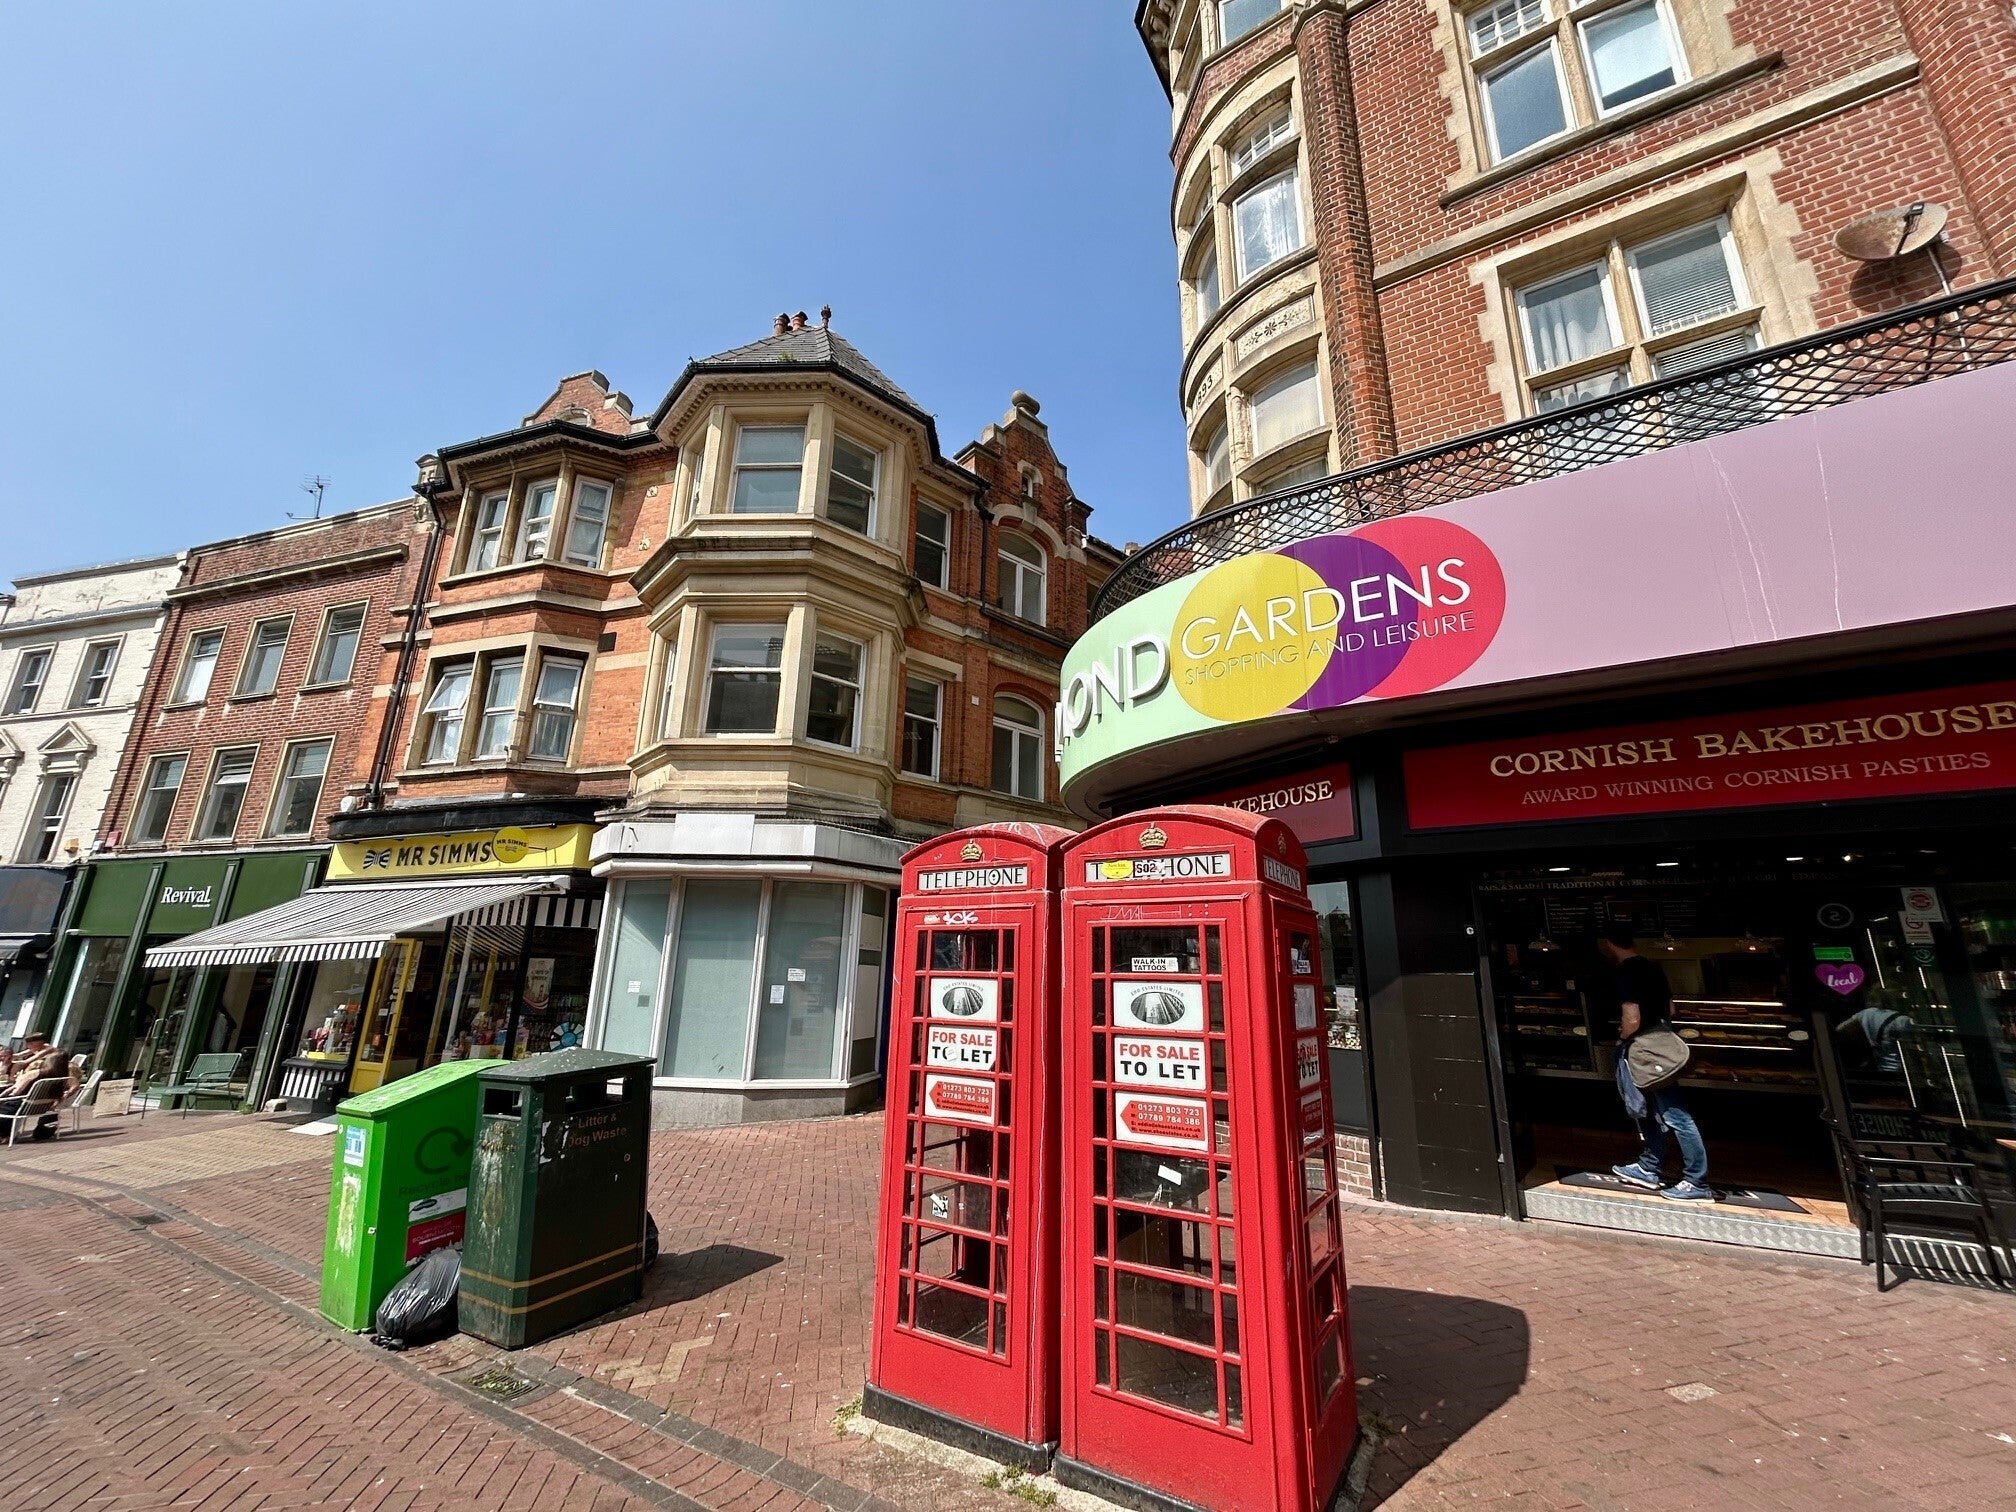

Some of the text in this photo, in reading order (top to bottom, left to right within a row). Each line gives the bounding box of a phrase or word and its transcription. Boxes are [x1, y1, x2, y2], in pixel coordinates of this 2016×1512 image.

[1181, 558, 1471, 660] GARDENS
[1185, 610, 1476, 686] SHOPPING AND LEISURE
[1490, 700, 2016, 778] CORNISH BAKEHOUSE
[1521, 752, 1992, 805] AWARD WINNING CORNISH PASTIES
[396, 841, 493, 866] MR SIMMS
[923, 868, 1023, 889] TELEPHONE
[932, 1031, 992, 1047] FOR SALE
[961, 1048, 992, 1063] LET
[1120, 1043, 1200, 1061] FOR SALE
[1120, 1060, 1200, 1080] TO LET
[1137, 1103, 1164, 1112] 01273
[1165, 1106, 1181, 1115] 803
[1184, 1108, 1200, 1116] 723
[1138, 1112, 1164, 1121] 07789
[1166, 1115, 1182, 1124] 784
[1184, 1117, 1200, 1126] 386
[578, 1114, 608, 1129] Litter
[592, 1127, 627, 1143] Waste
